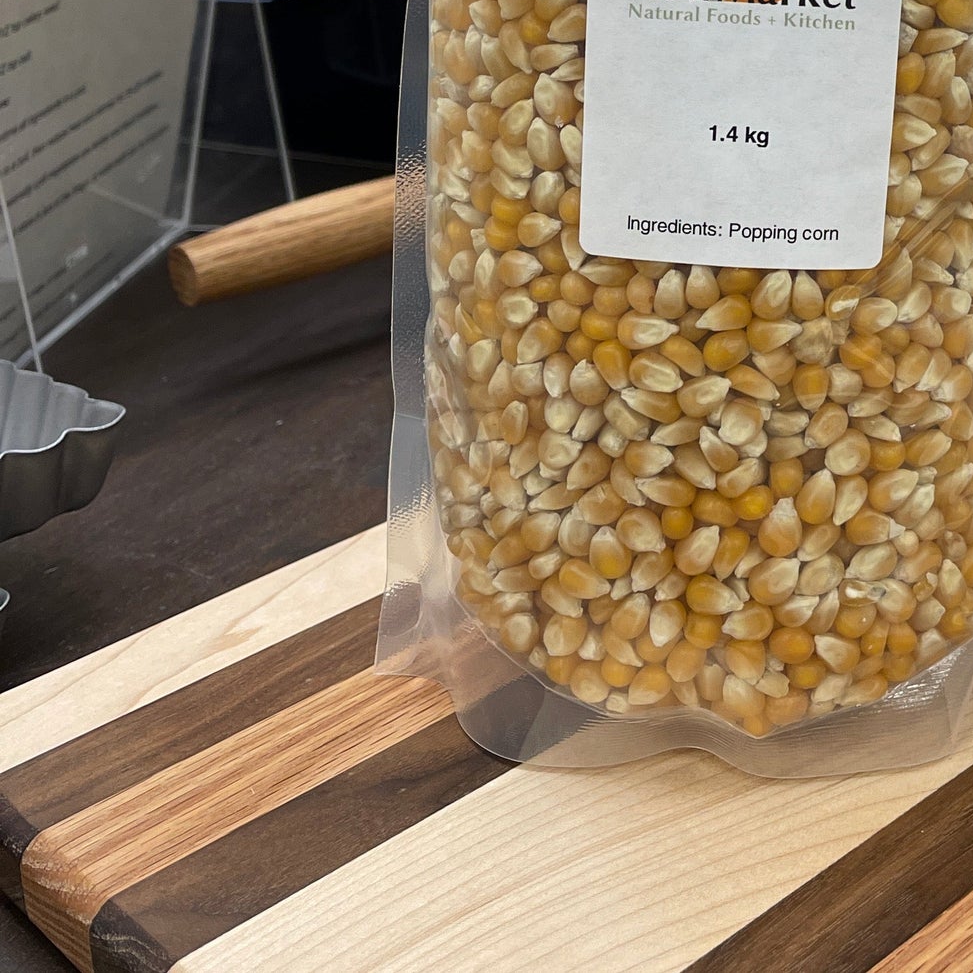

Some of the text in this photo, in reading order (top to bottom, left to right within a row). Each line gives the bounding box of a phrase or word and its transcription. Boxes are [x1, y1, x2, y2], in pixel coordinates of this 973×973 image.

[628, 2, 857, 31] Natural Foods + Kitchen
[709, 124, 770, 148] 1.4 kg
[627, 214, 839, 244] Ingredients: Popping corn
